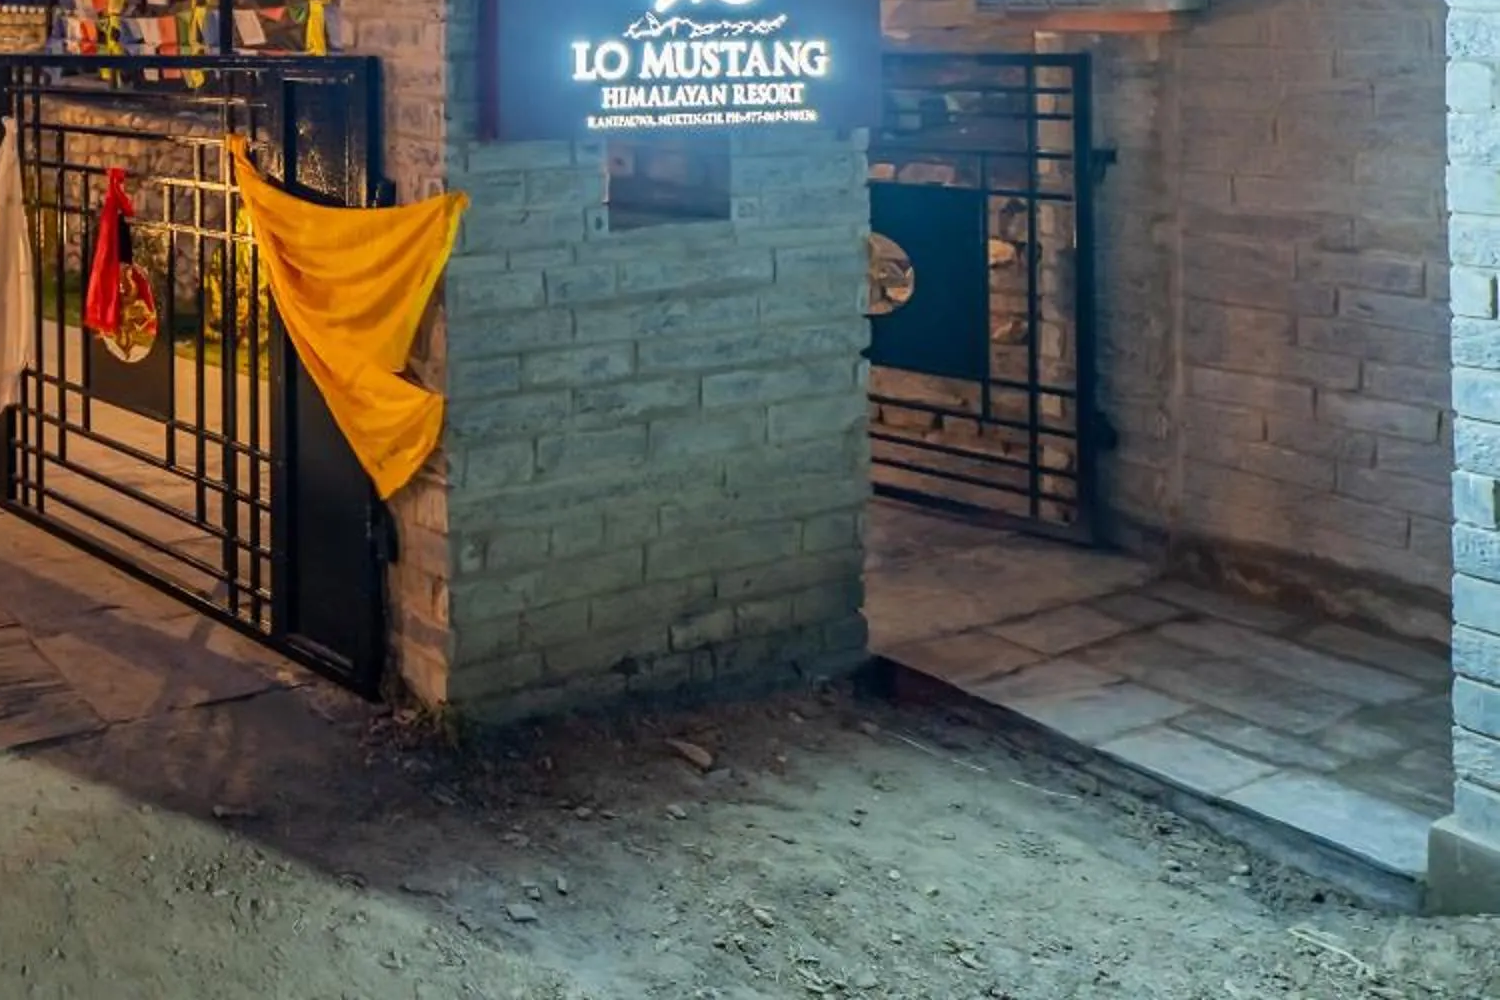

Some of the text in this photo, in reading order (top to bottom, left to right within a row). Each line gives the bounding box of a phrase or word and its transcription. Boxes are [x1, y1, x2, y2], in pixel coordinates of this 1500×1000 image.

[571, 40, 831, 81] LO MUSTANG
[601, 83, 804, 109] HIMALAYAN RESORT
